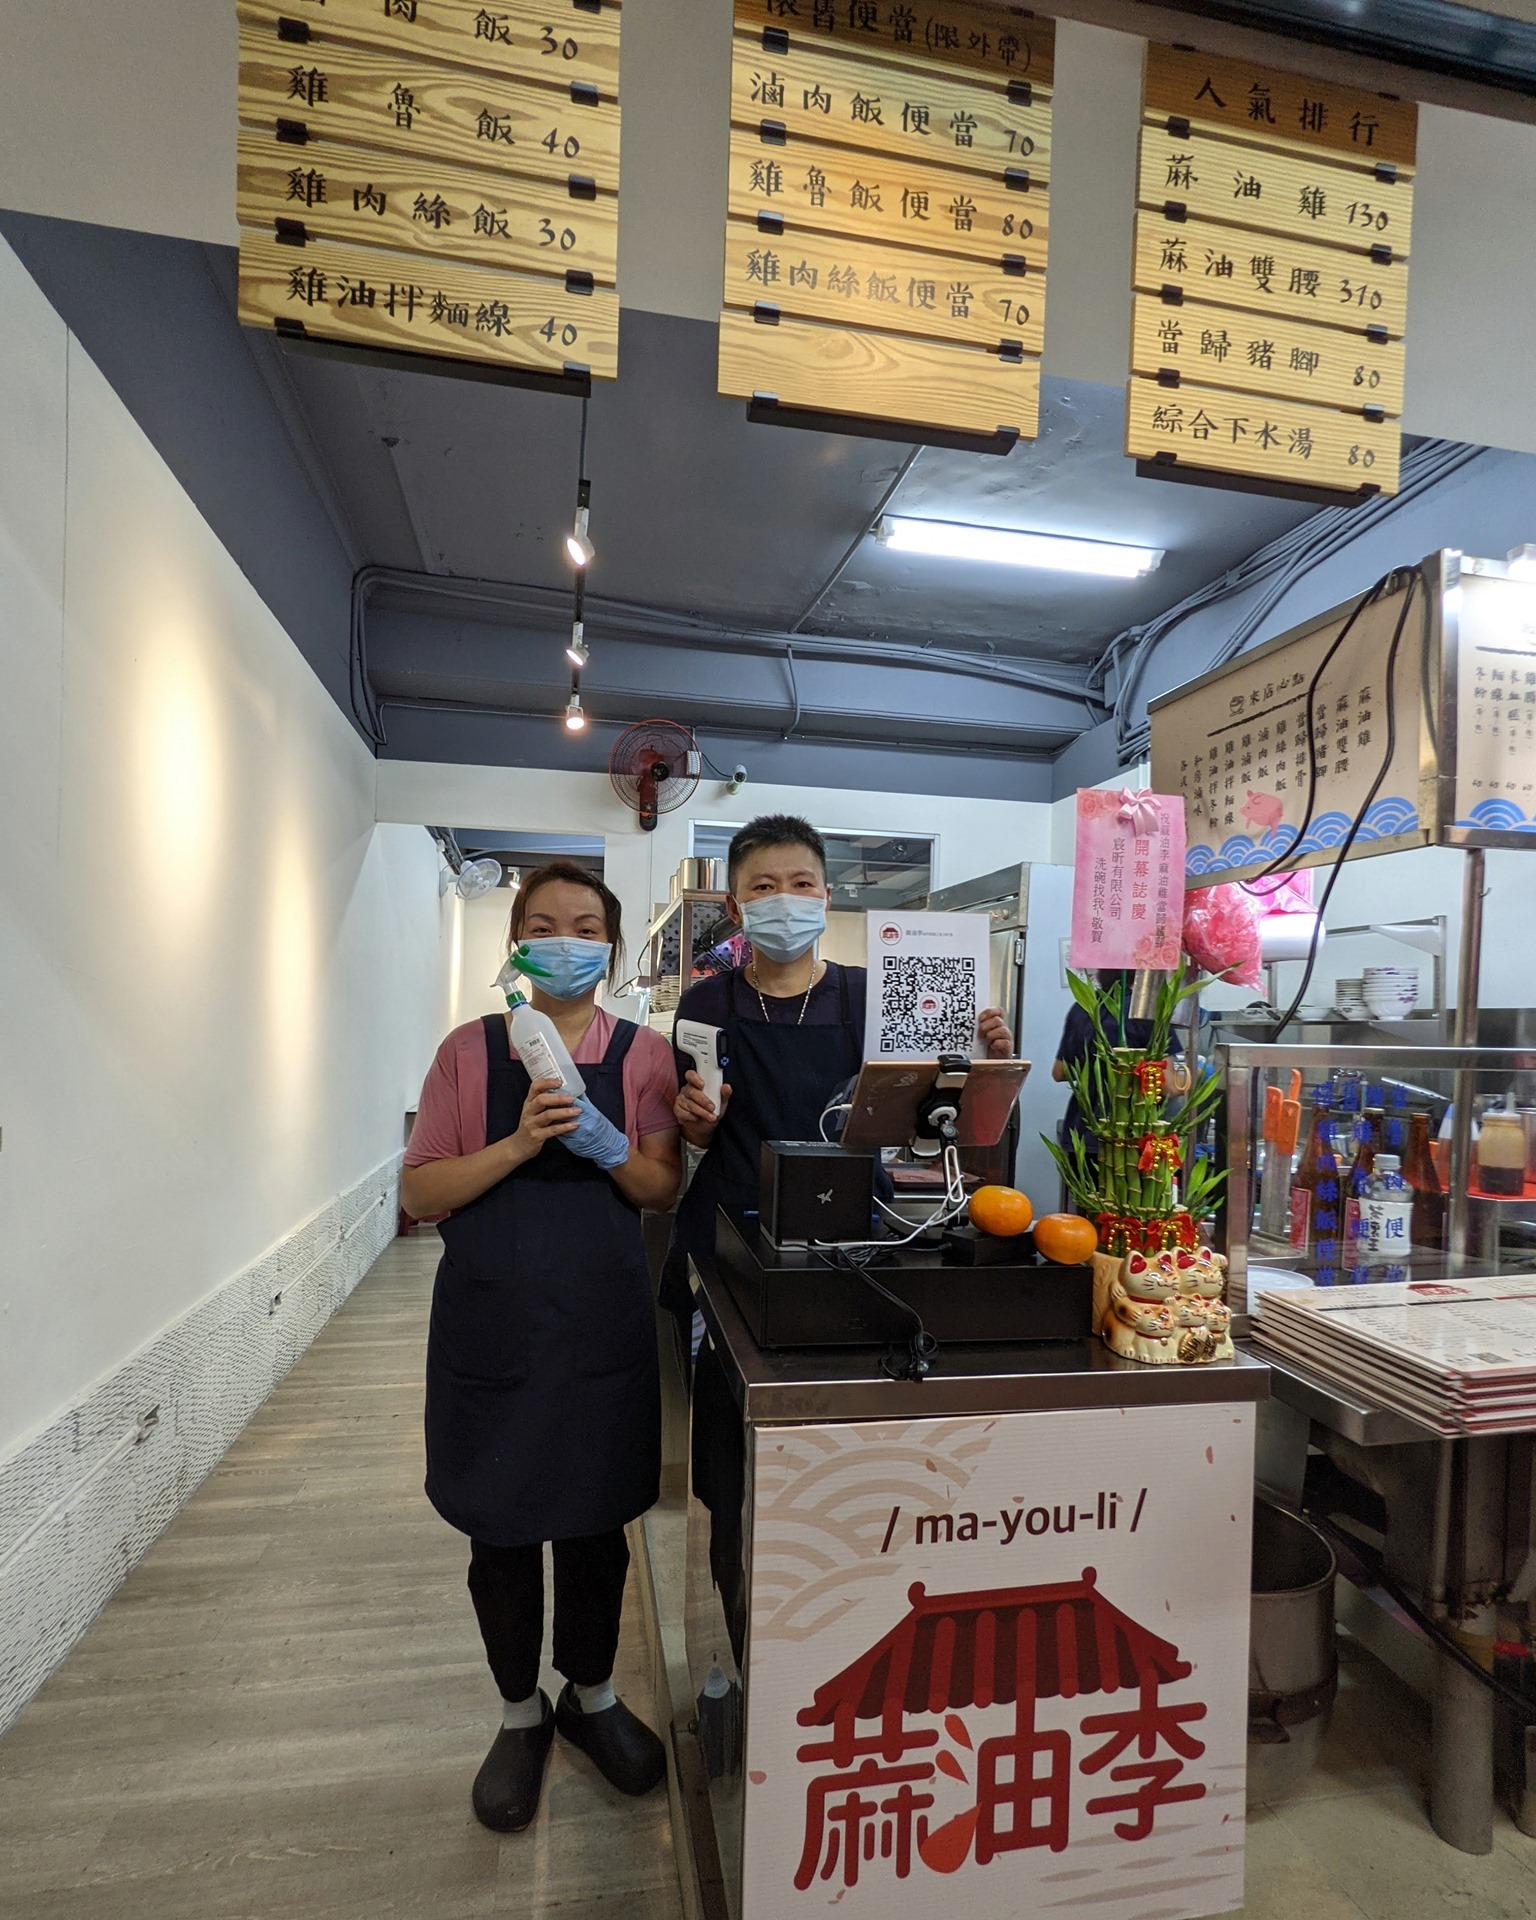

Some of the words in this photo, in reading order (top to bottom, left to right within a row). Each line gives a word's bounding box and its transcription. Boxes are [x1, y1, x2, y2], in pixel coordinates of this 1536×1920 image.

[299, 0, 513, 46] 肉飯
[540, 27, 578, 60] 30
[286, 65, 516, 146] 雞魯飯
[541, 128, 581, 158] 40
[750, 71, 978, 148] 滷肉飯便當
[1005, 130, 1035, 157] 70
[1194, 77, 1380, 147] 人氣排行
[285, 166, 512, 239] 雞肉絲飯
[538, 218, 576, 251] 30
[749, 159, 978, 233] 雞魯飯便當
[1002, 213, 1033, 239] 80
[1345, 202, 1389, 232] 130
[286, 266, 512, 338] 雞油拌麵線
[540, 316, 578, 347] 40
[745, 248, 975, 319] 雞肉絲飯便當
[1000, 299, 1030, 326] 70
[1158, 319, 1319, 376] 當歸豬腳
[1353, 365, 1380, 389] 80
[1152, 404, 1315, 460] 綜合下水湯
[1348, 445, 1375, 468] 80
[1131, 839, 1149, 920] 開幕誌慶
